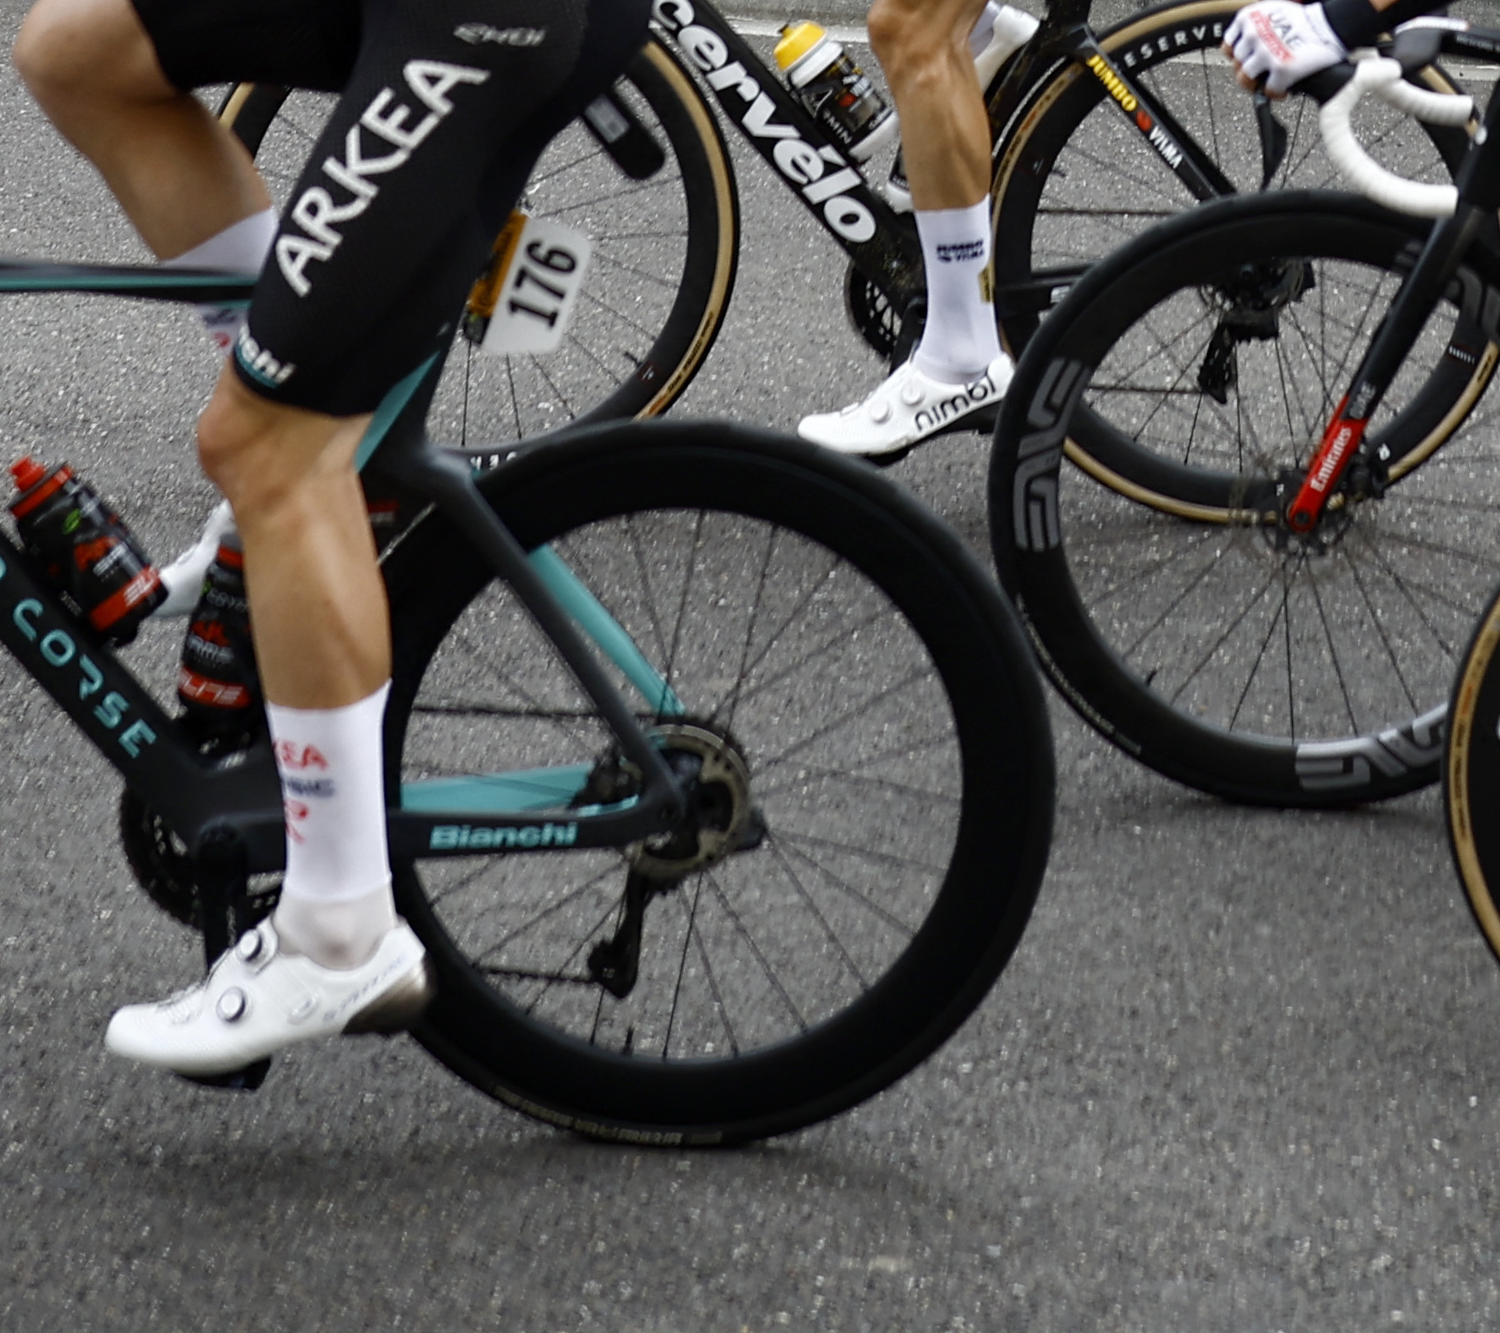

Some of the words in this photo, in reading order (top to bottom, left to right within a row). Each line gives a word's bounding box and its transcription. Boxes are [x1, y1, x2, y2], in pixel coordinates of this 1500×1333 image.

[1114, 21, 1224, 68] ESERVE
[1086, 54, 1138, 113] JUMBO
[275, 58, 491, 295] ARKEA
[1148, 126, 1185, 171] VISMA
[508, 239, 579, 331] 176
[914, 375, 997, 432] nimbl
[11, 597, 157, 758] CORSE
[430, 821, 579, 850] Bianchi
